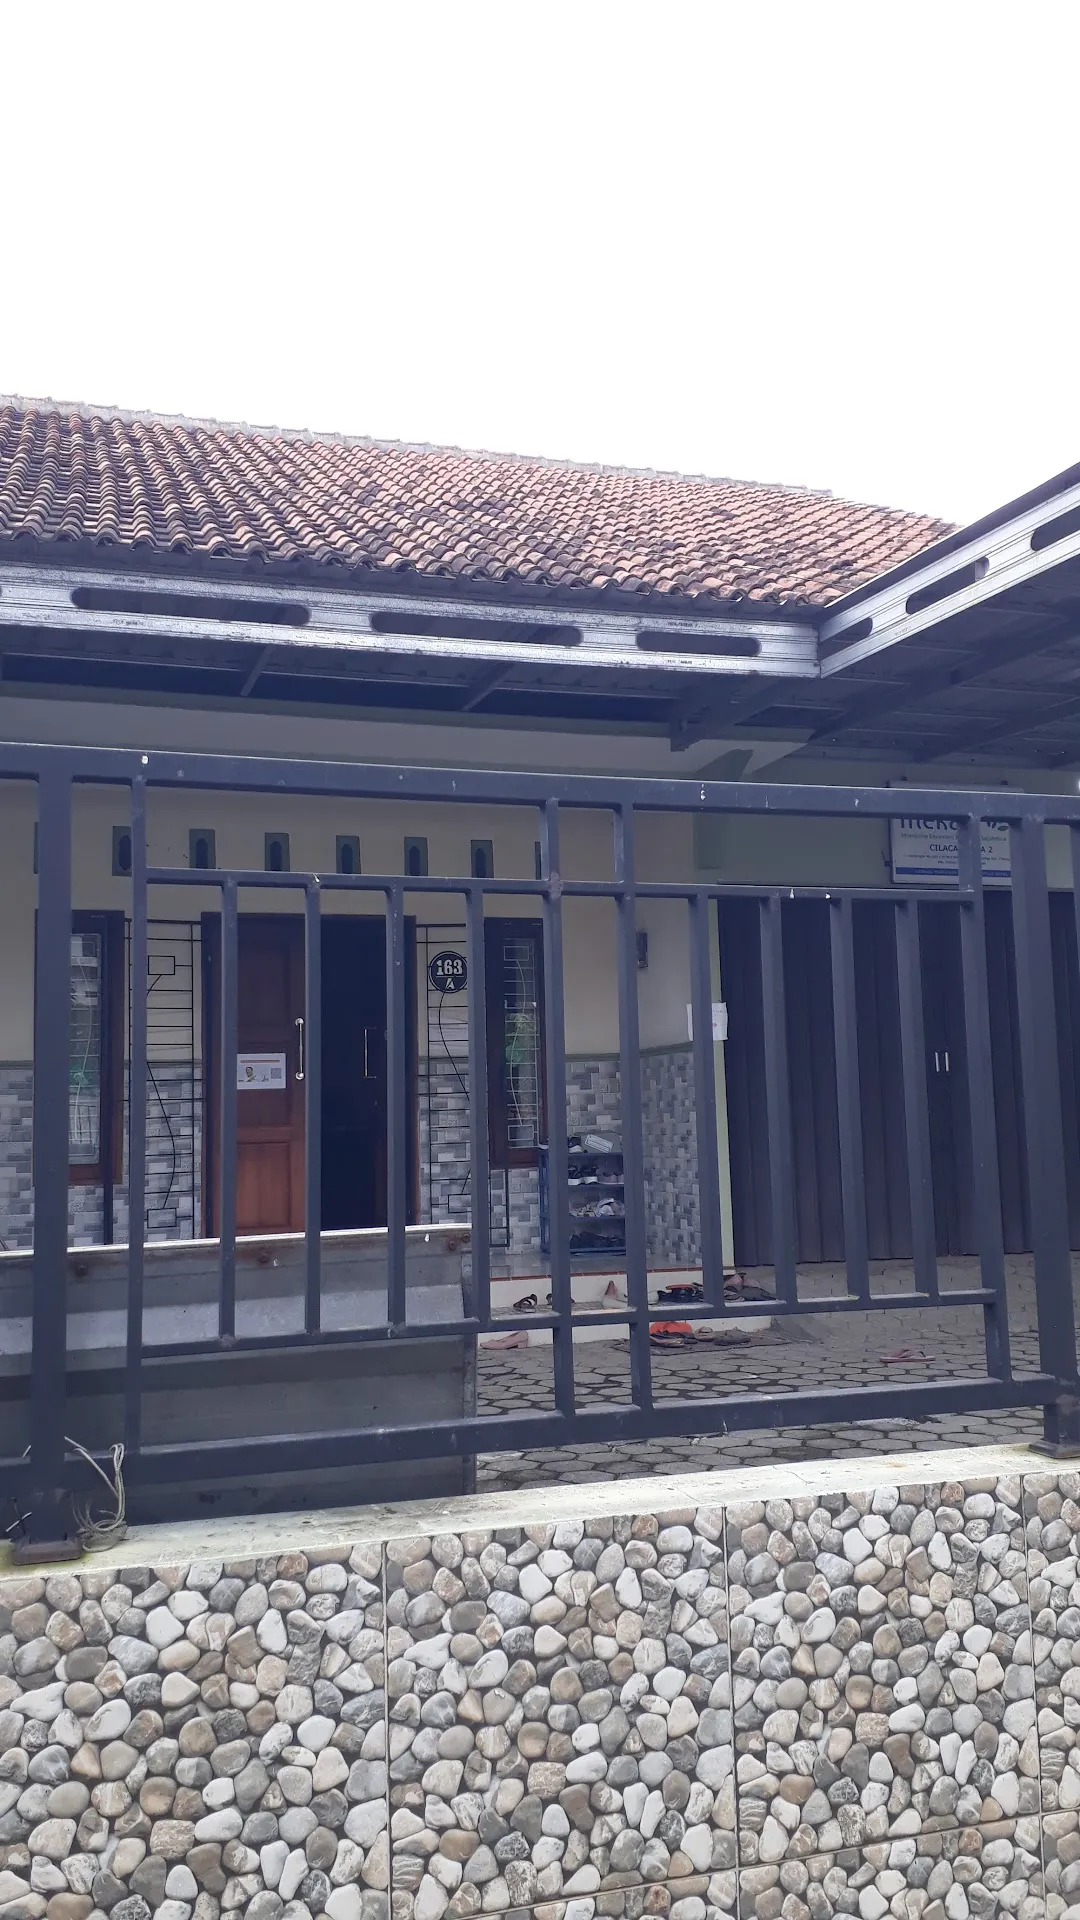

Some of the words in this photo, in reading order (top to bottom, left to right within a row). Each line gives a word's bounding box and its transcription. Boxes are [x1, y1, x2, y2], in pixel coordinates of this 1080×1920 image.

[929, 844, 958, 852] CILACA
[436, 959, 463, 975] 163
[446, 977, 455, 989] A
